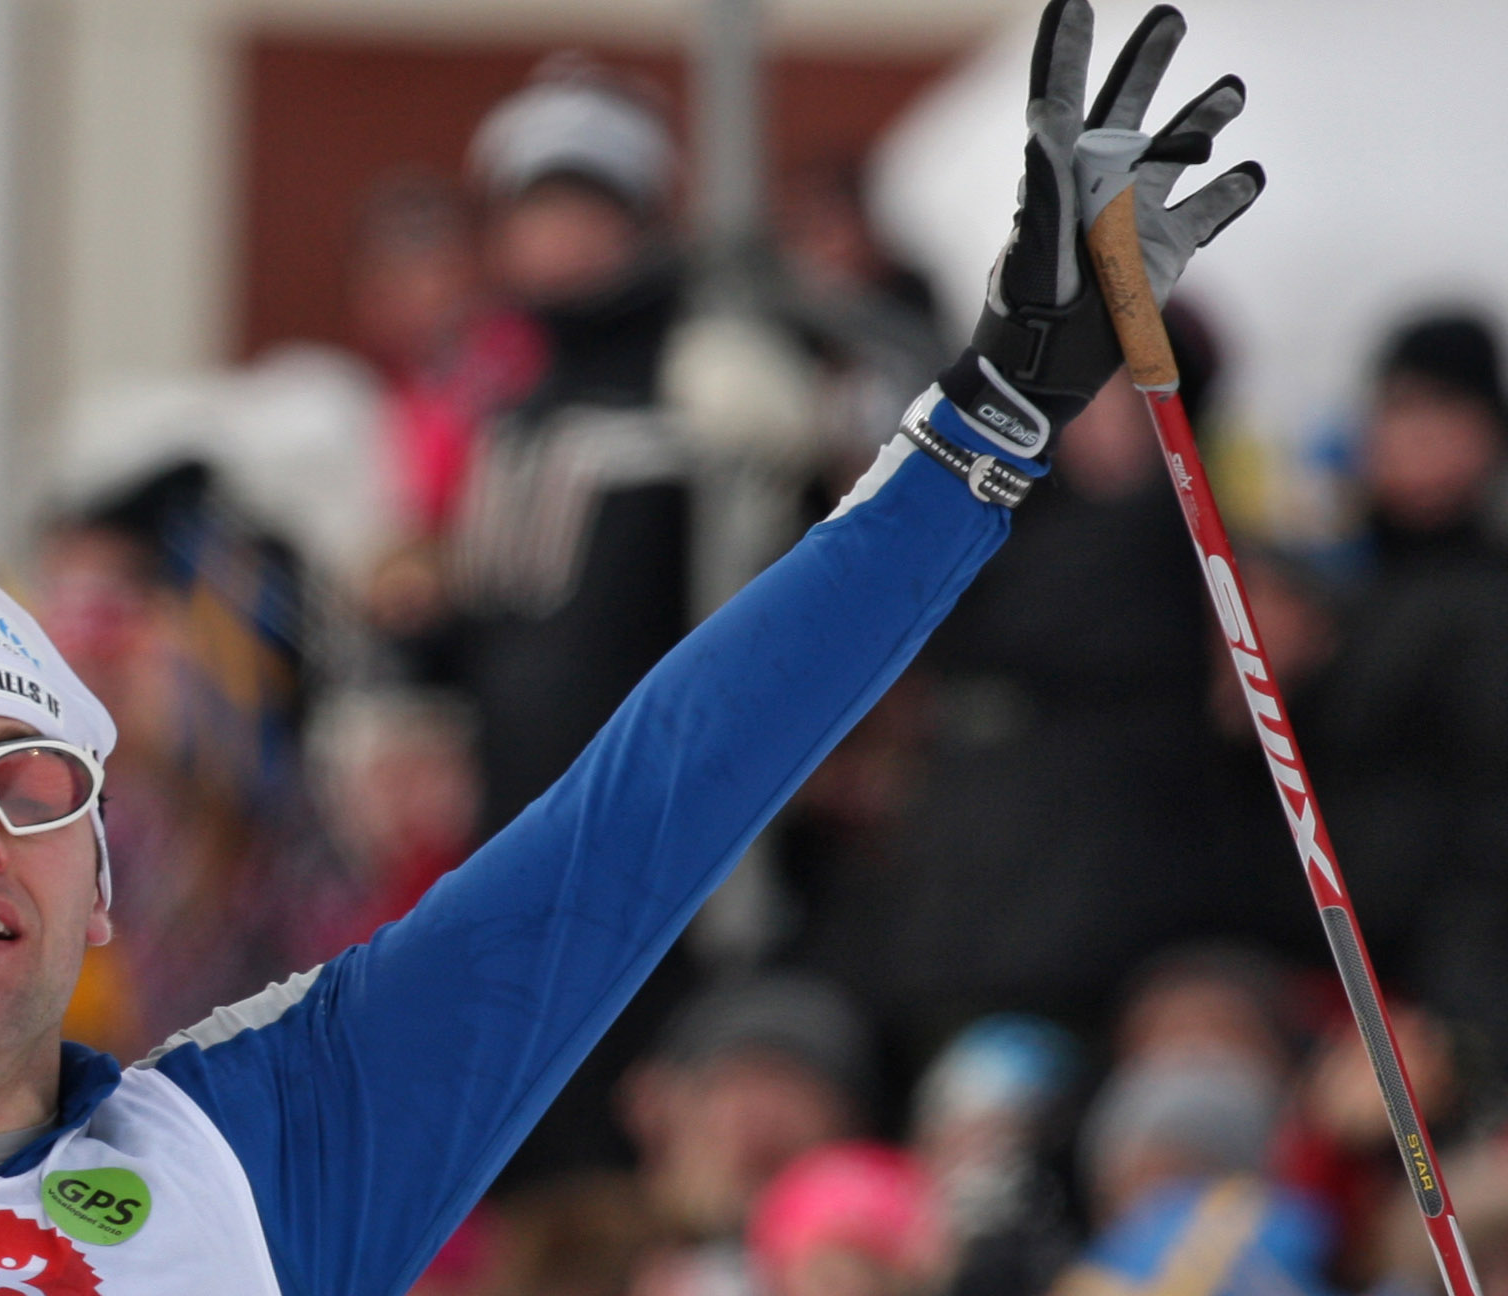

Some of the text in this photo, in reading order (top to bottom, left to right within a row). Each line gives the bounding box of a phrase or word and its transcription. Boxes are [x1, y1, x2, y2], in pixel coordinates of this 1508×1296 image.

[46, 692, 61, 719] IF
[1200, 546, 1342, 898] SWIX
[1407, 1133, 1434, 1190] STAR
[57, 1178, 142, 1225] GPS
[98, 1223, 123, 1236] 2010
